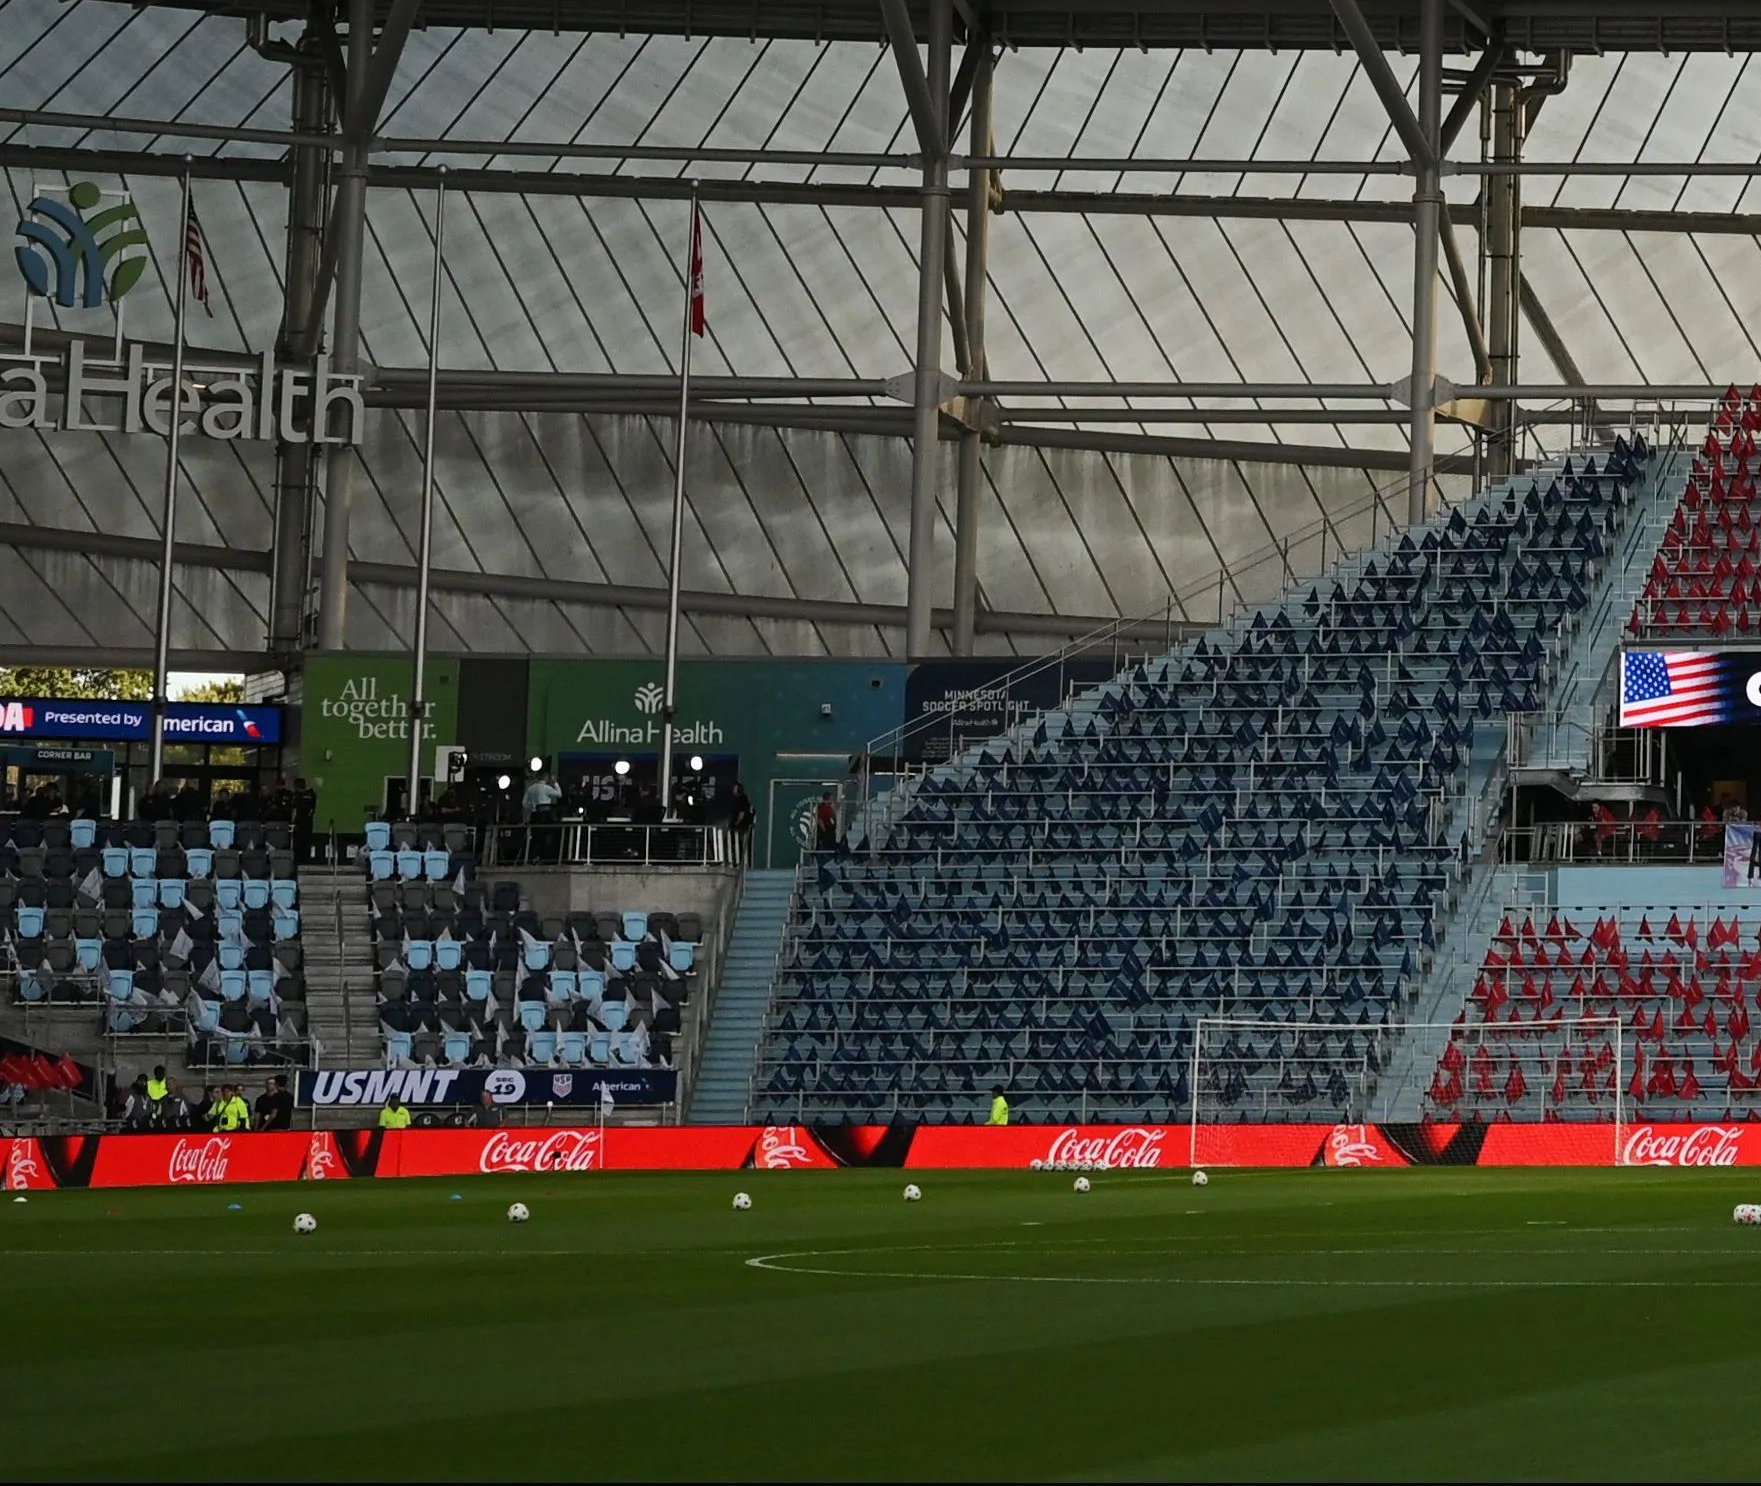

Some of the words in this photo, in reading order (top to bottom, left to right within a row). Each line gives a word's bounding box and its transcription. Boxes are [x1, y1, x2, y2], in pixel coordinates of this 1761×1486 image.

[340, 677, 376, 700] All
[321, 694, 436, 724] togethr
[967, 700, 1030, 711] SPOTLGHT
[45, 711, 121, 725] Presented
[124, 712, 142, 727] by
[163, 716, 234, 733] merican
[359, 716, 437, 739] bettr.
[38, 750, 72, 759] CORNER
[74, 751, 91, 760] BAR
[312, 1070, 460, 1105] USMNT
[492, 1083, 516, 1095] 19
[480, 1130, 600, 1173] Coca-Cola
[1047, 1127, 1168, 1168] Coca-Cola
[1623, 1126, 1745, 1166] Coca-Cola
[169, 1137, 231, 1182] Coca-Cola
